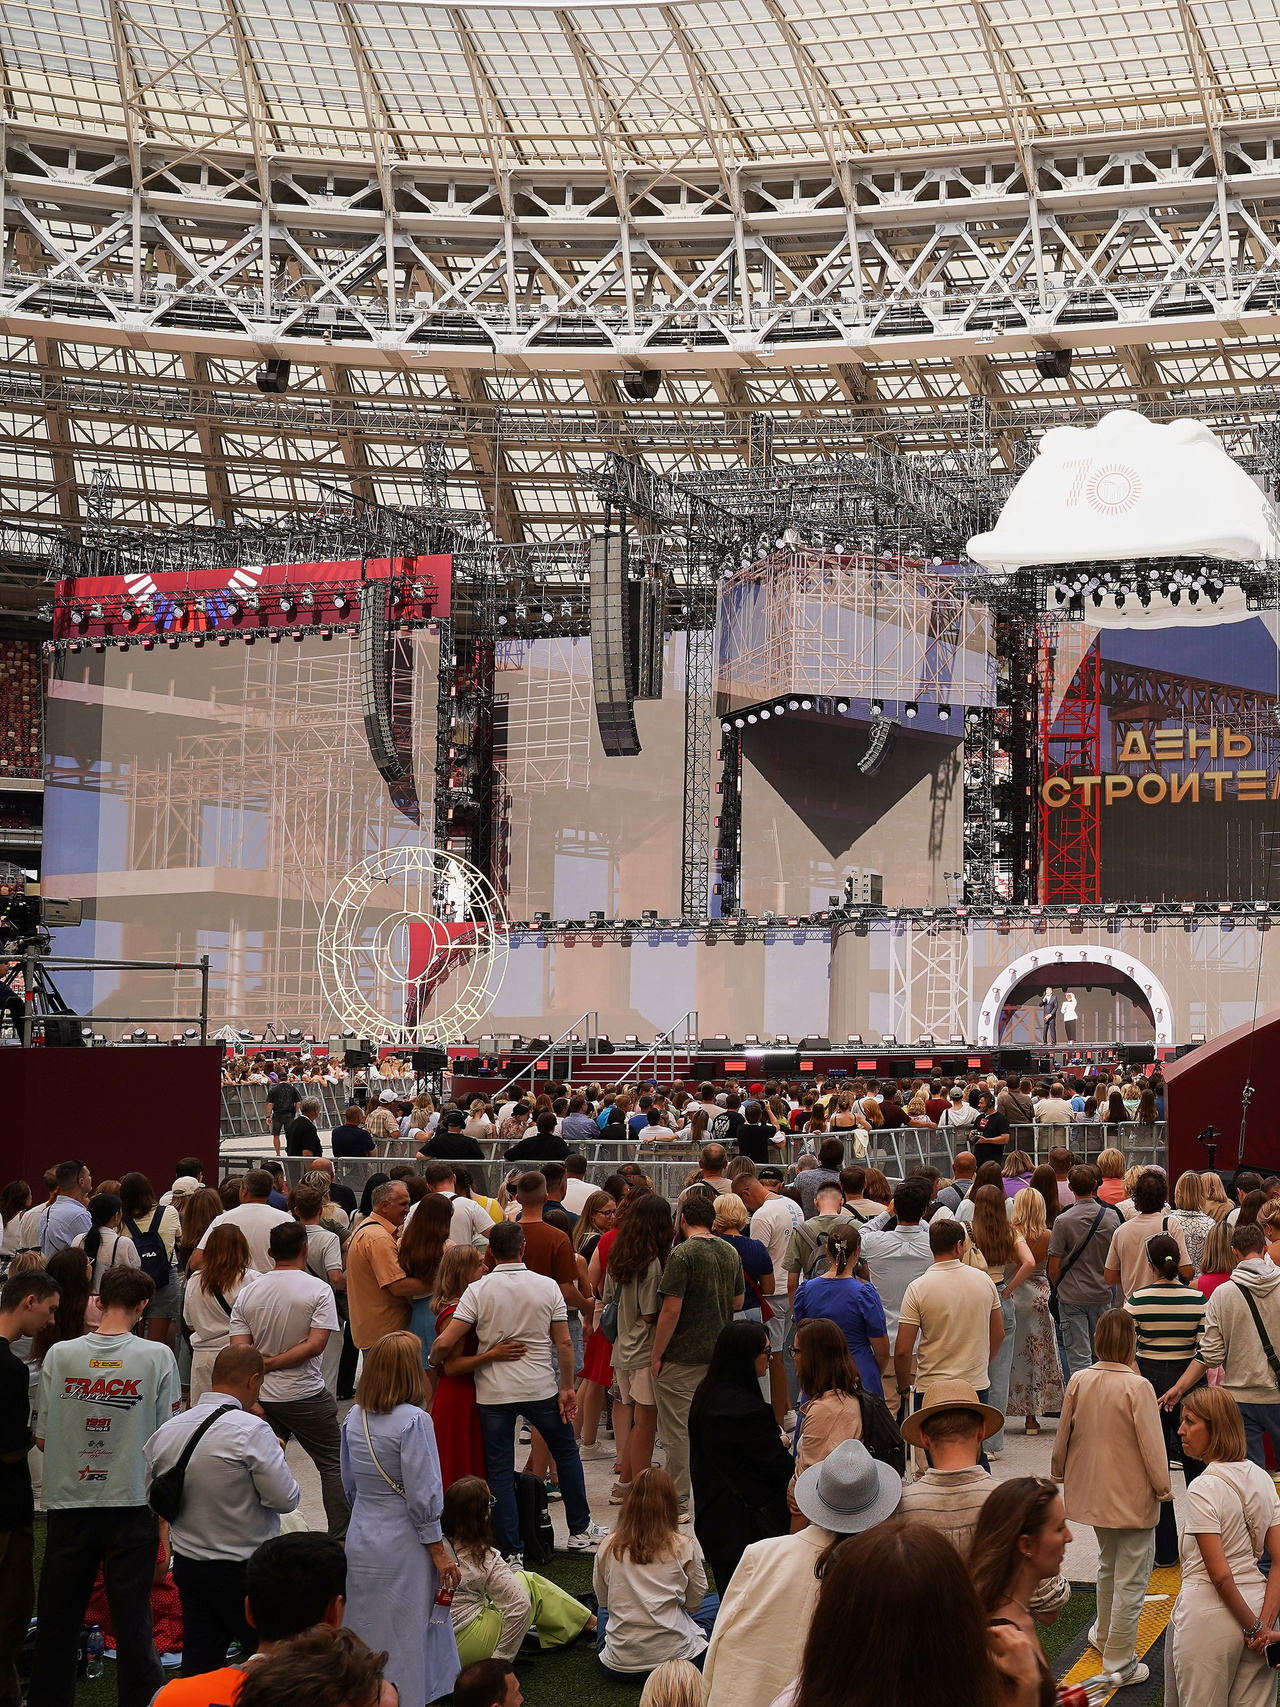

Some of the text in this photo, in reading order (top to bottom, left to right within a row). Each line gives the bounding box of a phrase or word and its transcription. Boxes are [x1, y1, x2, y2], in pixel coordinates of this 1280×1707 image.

[1119, 727, 1252, 761] ДЕНЬ
[64, 1377, 143, 1396] TRACK
[85, 1418, 112, 1426] 1991
